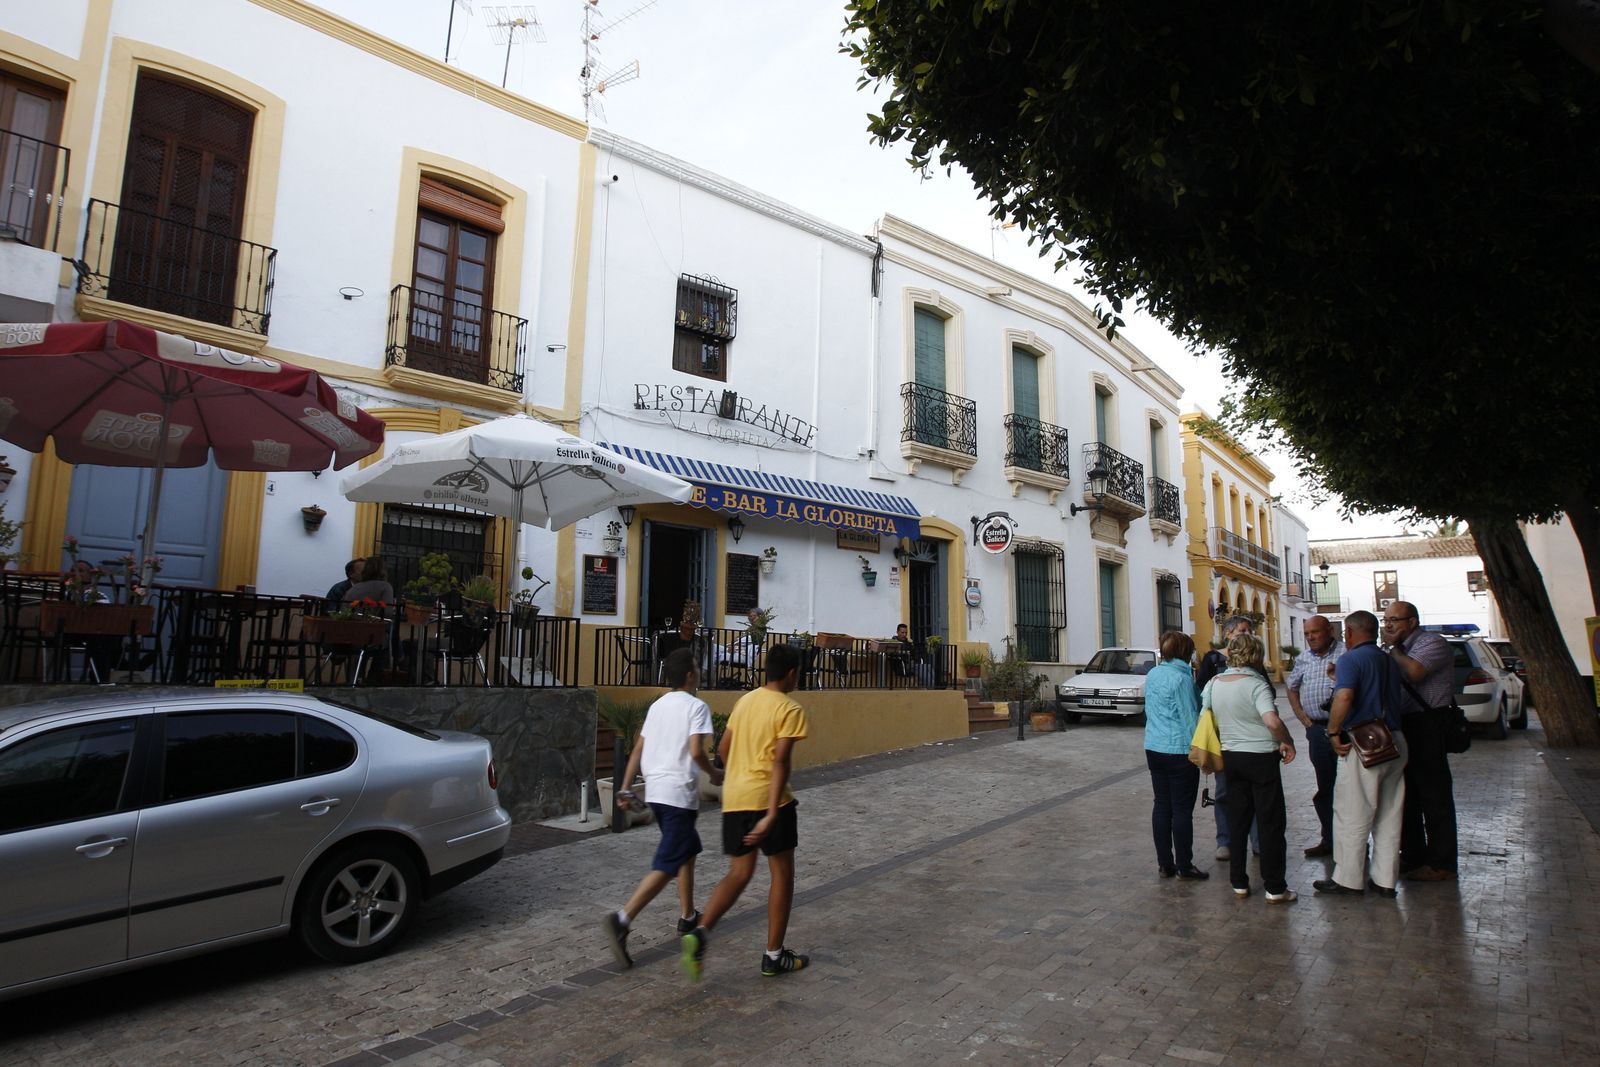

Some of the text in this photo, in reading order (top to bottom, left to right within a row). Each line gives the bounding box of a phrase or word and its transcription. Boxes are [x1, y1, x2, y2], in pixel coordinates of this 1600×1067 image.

[634, 383, 819, 448] RESTARANTE
[556, 447, 590, 460] Estrella
[722, 491, 767, 514] BAR
[776, 499, 800, 519] LA
[803, 505, 898, 534] GLORIETA
[985, 528, 1007, 536] Estrella
[986, 535, 1006, 543] Galicia
